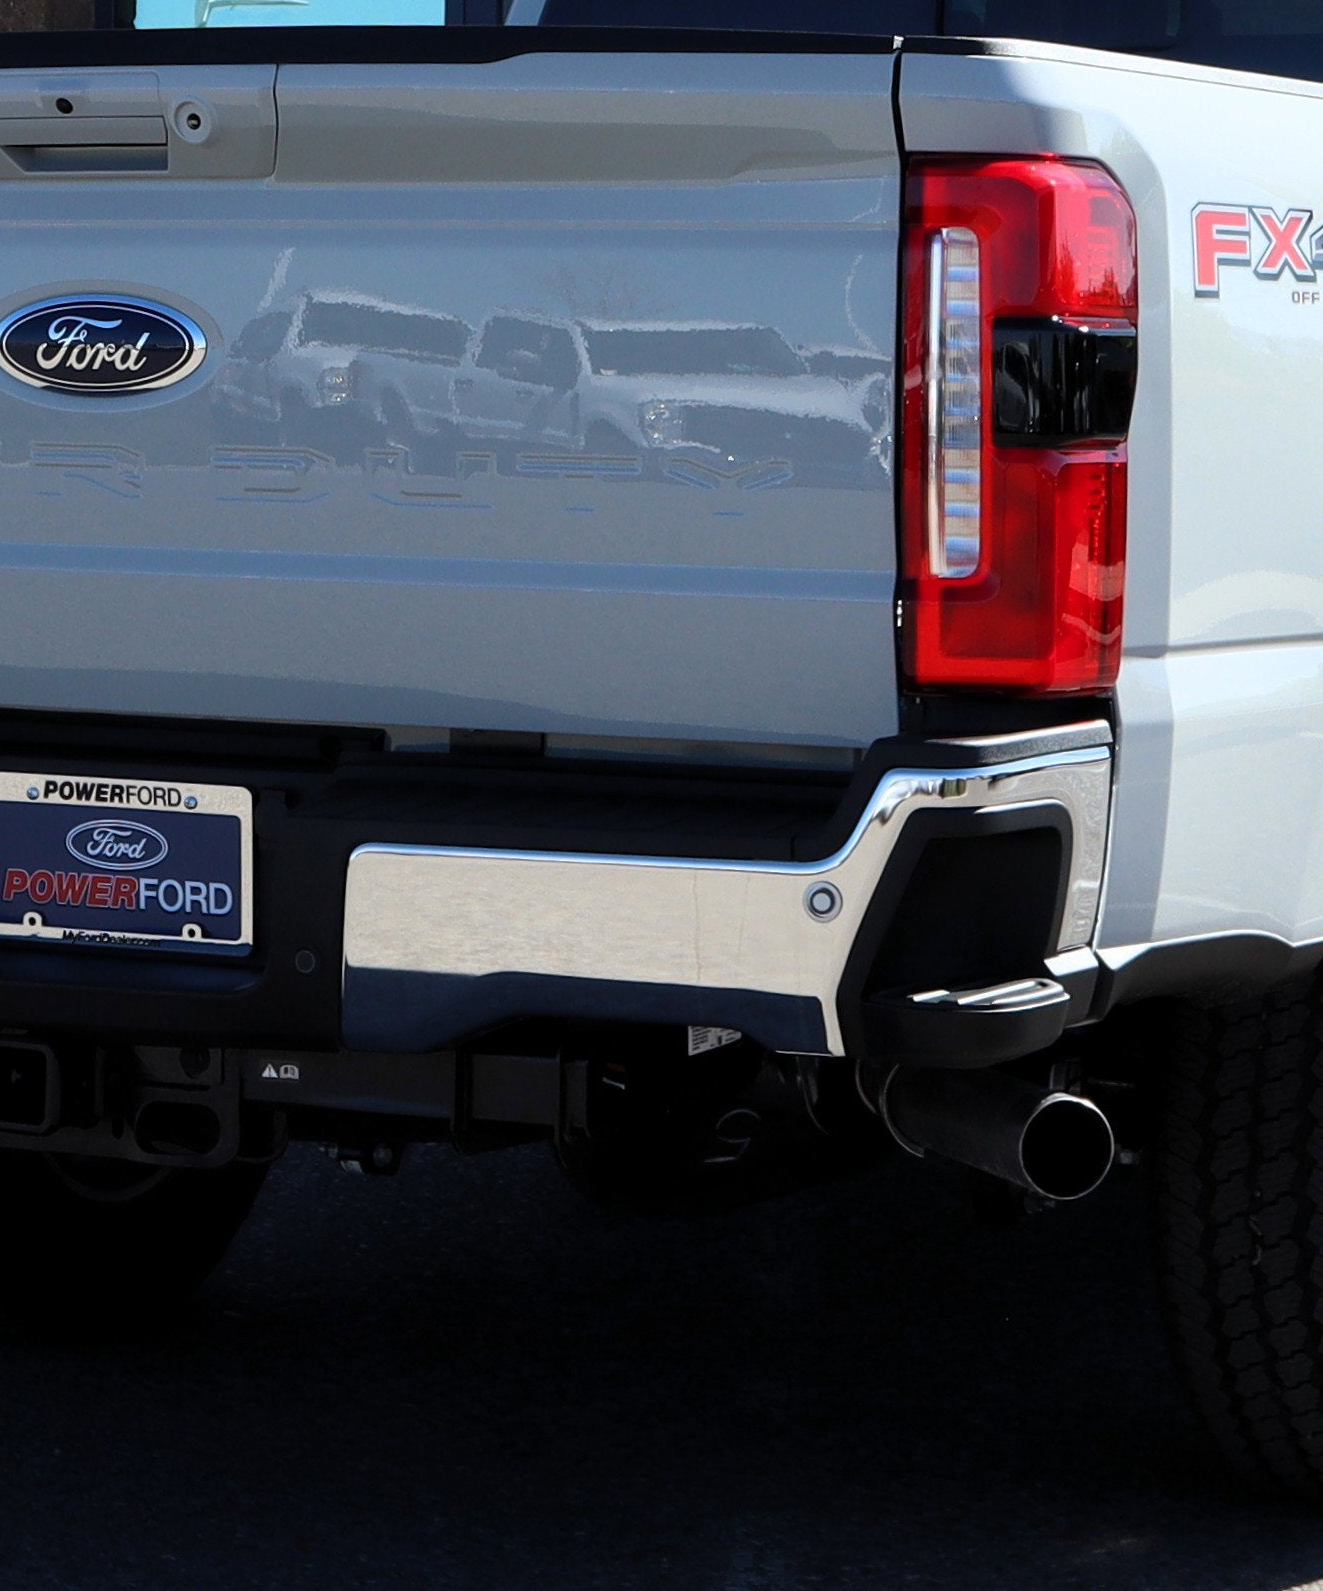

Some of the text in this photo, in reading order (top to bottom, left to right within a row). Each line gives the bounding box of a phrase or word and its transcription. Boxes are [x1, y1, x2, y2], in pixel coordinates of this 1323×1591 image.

[1291, 291, 1321, 305] OFF
[36, 315, 150, 371] Ford
[207, 444, 796, 518] DUTY
[86, 826, 146, 860] Ford
